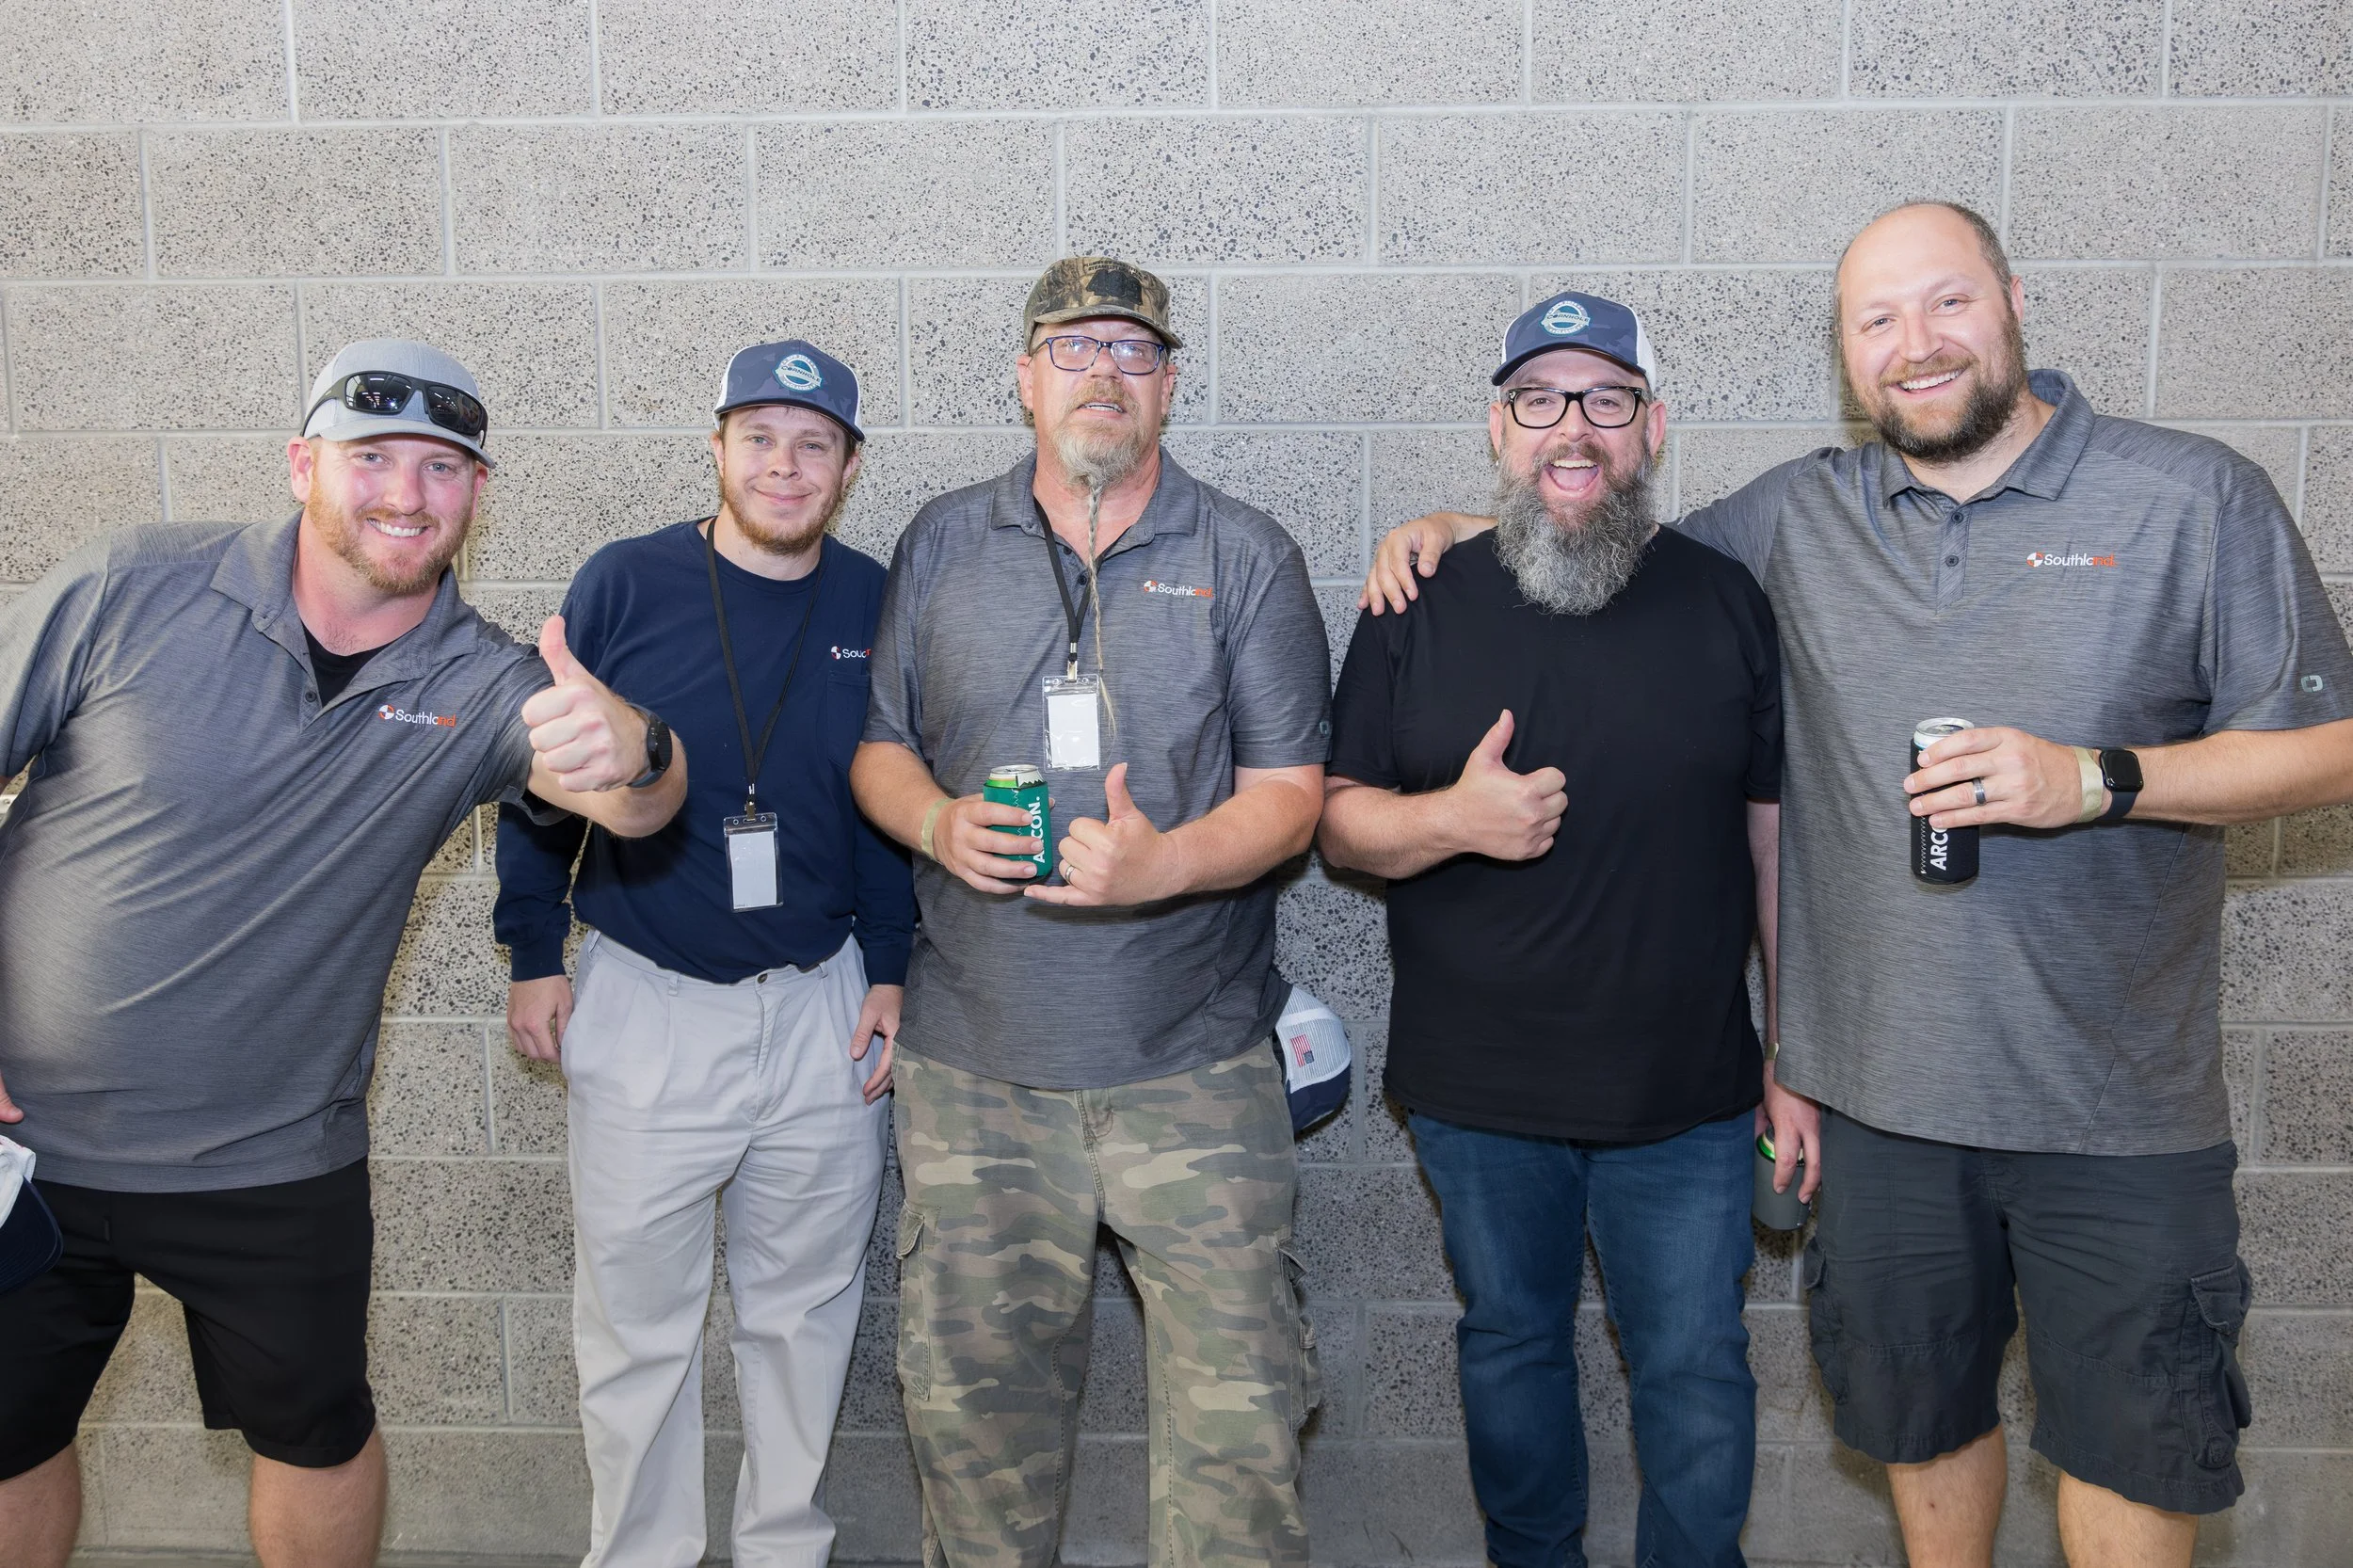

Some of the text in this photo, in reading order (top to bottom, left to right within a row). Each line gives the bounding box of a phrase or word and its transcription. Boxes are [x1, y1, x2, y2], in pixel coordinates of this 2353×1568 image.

[1546, 313, 1589, 322] CORNHOLE
[781, 365, 820, 382] CORNHOLE
[2044, 552, 2114, 567] Southland
[1158, 583, 1213, 598] Southland
[395, 709, 456, 728] Southland
[1028, 796, 1045, 863] ACON.
